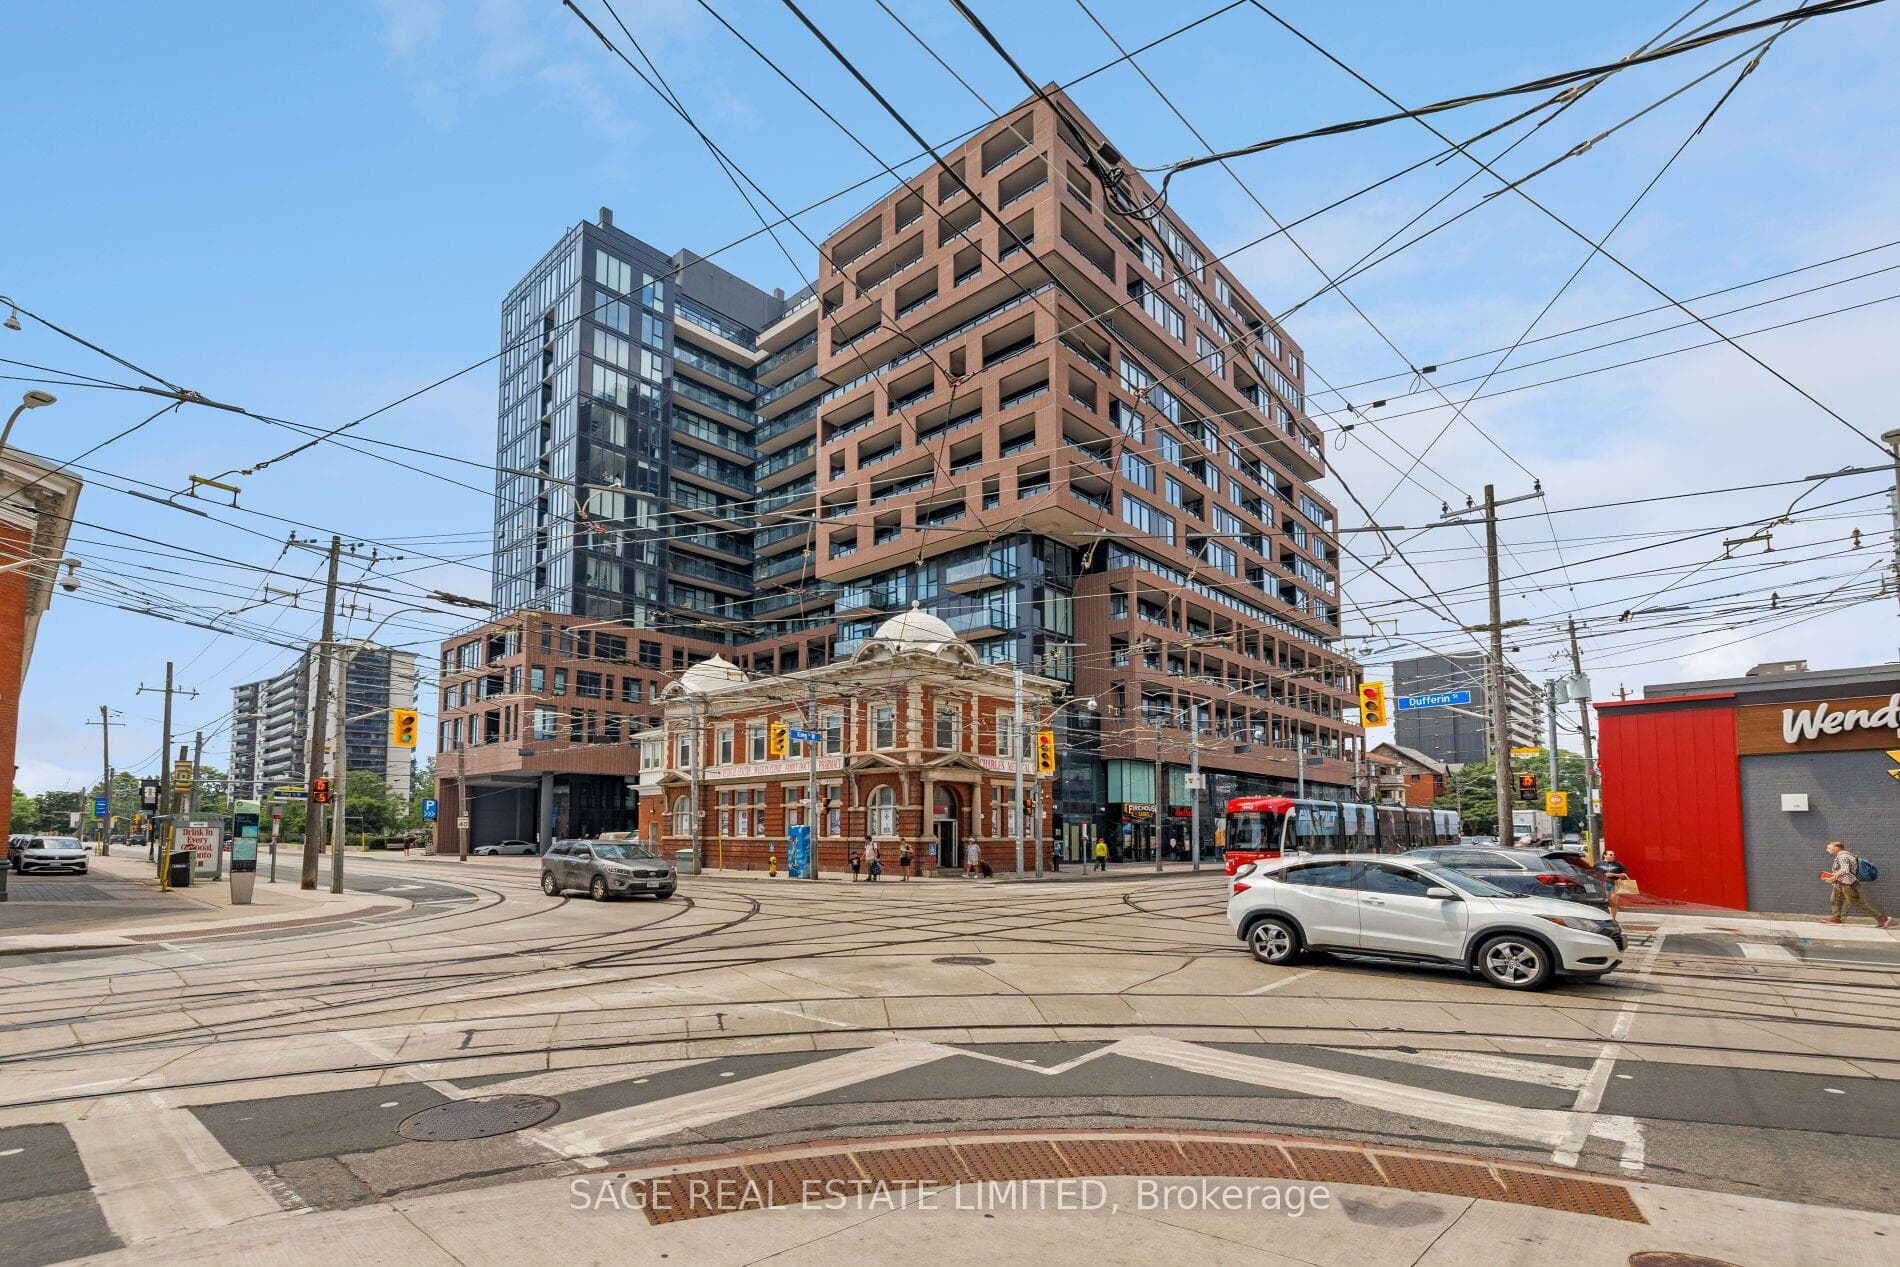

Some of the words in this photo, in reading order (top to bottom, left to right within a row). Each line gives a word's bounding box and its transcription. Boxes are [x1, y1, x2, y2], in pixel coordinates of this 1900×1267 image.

[1409, 694, 1450, 706] Dufferin
[979, 758, 1005, 770] CHARLES
[426, 800, 435, 810] P
[187, 836, 208, 844] Every
